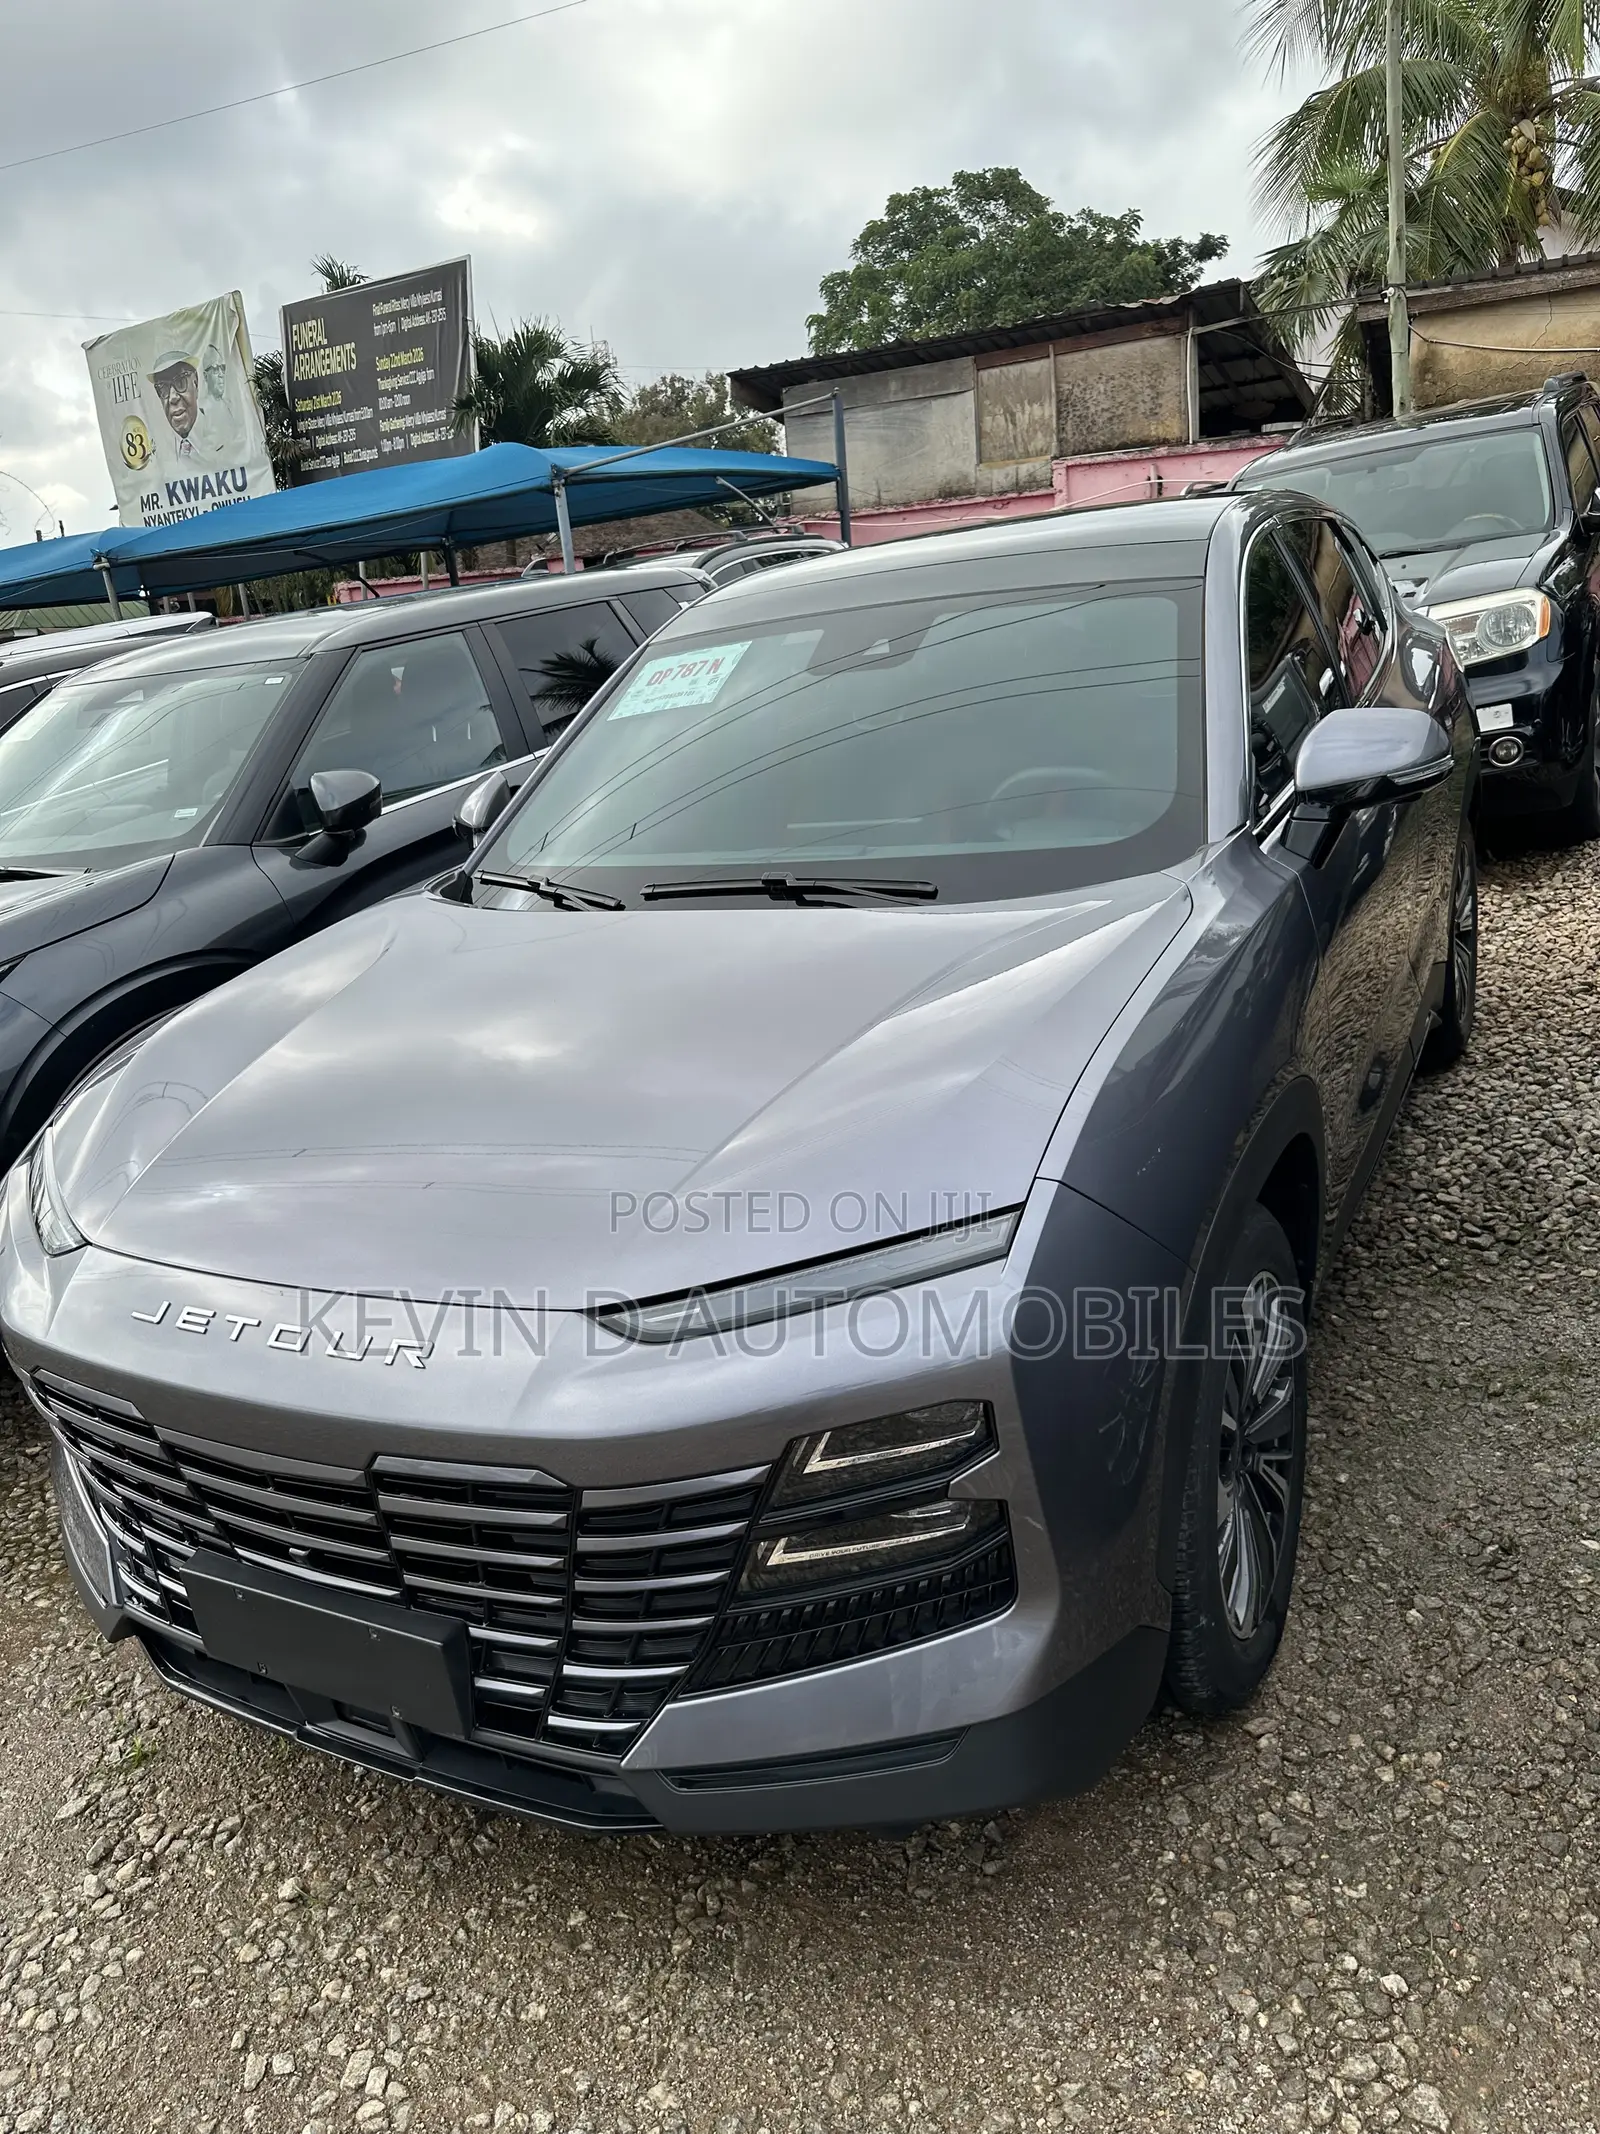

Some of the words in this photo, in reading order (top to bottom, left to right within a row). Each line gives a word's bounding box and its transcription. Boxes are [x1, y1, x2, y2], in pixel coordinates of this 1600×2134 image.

[292, 318, 327, 351] FUNERAL
[294, 342, 356, 381] ARRANGEMENTS
[376, 354, 390, 372] Sunday
[112, 372, 141, 404] LIFE
[126, 432, 146, 460] 83
[140, 493, 163, 512] MR.
[165, 466, 248, 506] KWAKU
[143, 506, 200, 527] NYANTEKYI
[672, 660, 708, 680] 787
[706, 657, 725, 675] N
[131, 1300, 435, 1369] JETOUR
[808, 1550, 829, 1559] DRIVE
[831, 1548, 850, 1556] YOUR
[851, 1544, 881, 1553] FUTURE
